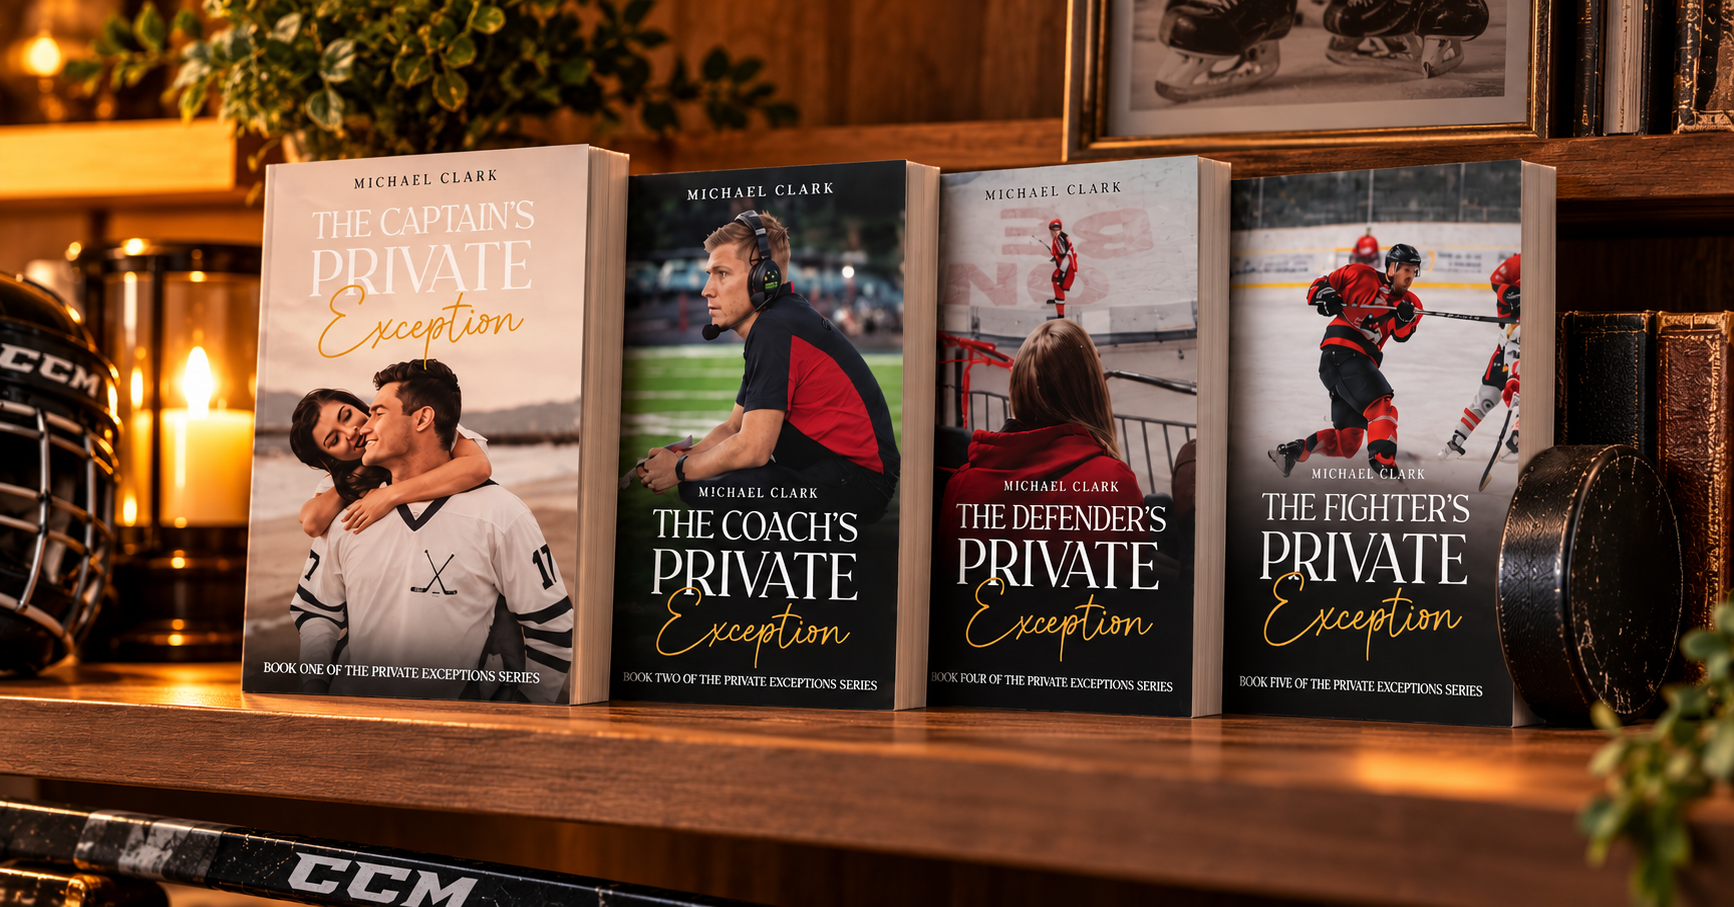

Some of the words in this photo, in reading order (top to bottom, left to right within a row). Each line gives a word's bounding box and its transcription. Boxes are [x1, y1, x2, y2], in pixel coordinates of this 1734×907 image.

[354, 173, 431, 189] MICHAEL
[440, 169, 498, 184] CLARK
[687, 185, 767, 201] MICHAEL
[774, 182, 834, 196] CLARK
[985, 185, 1059, 201] MICHAEL
[1067, 181, 1122, 196] CLARK
[312, 209, 372, 240] THE
[380, 200, 535, 236] CAPTAIN'S
[309, 240, 533, 297] PRIVATE
[318, 284, 524, 370] Exception
[0, 343, 100, 399] CCM
[1004, 480, 1067, 492] MICHAEL
[1072, 481, 1119, 493] CLARK
[1311, 468, 1374, 480] MICHAEL
[1379, 468, 1425, 480] CLARK
[770, 487, 818, 499] CLARK
[1262, 493, 1317, 521] THE
[1323, 493, 1470, 523] FIGHTER'S
[653, 508, 715, 539] THE
[722, 510, 858, 543] COACH'S
[956, 503, 1007, 530] THE
[1012, 504, 1167, 533] DEFENDER'S
[532, 543, 557, 590] 17
[651, 548, 858, 601] PRIVATE
[956, 538, 1160, 590] PRIVATE
[1259, 531, 1468, 585] PRIVATE
[656, 586, 851, 669] Exception
[966, 577, 1154, 662] Exception
[1263, 571, 1463, 661] Exception
[264, 661, 297, 674] BOOK
[300, 663, 324, 675] ONE
[327, 664, 343, 676] OF
[344, 665, 369, 677] THE
[371, 666, 419, 679] PRIVATE
[422, 668, 496, 682] EXCEPTIONS
[499, 670, 540, 684] SERIES
[623, 671, 653, 683] BOOK
[655, 672, 681, 684] TWO
[683, 673, 698, 684] OF
[699, 674, 722, 685] THE
[724, 675, 767, 687] PRIVATE
[770, 677, 837, 690] EXCEPTIONS
[839, 679, 878, 691] SERIES
[931, 671, 959, 683] BOOK
[960, 672, 987, 684] FOUR
[988, 673, 1003, 684] OF
[1004, 674, 1026, 686] THE
[1027, 675, 1068, 688] PRIVATE
[1070, 677, 1135, 691] EXCEPTIONS
[1136, 680, 1173, 693] SERIES
[1239, 675, 1268, 688] BOOK
[1270, 676, 1293, 689] FIVE
[1294, 677, 1309, 689] OF
[1310, 678, 1331, 690] THE
[1333, 679, 1375, 692] PRIVATE
[1377, 681, 1443, 695] EXCEPTIONS
[1445, 683, 1483, 697] SERIES
[287, 852, 478, 907] CCM
